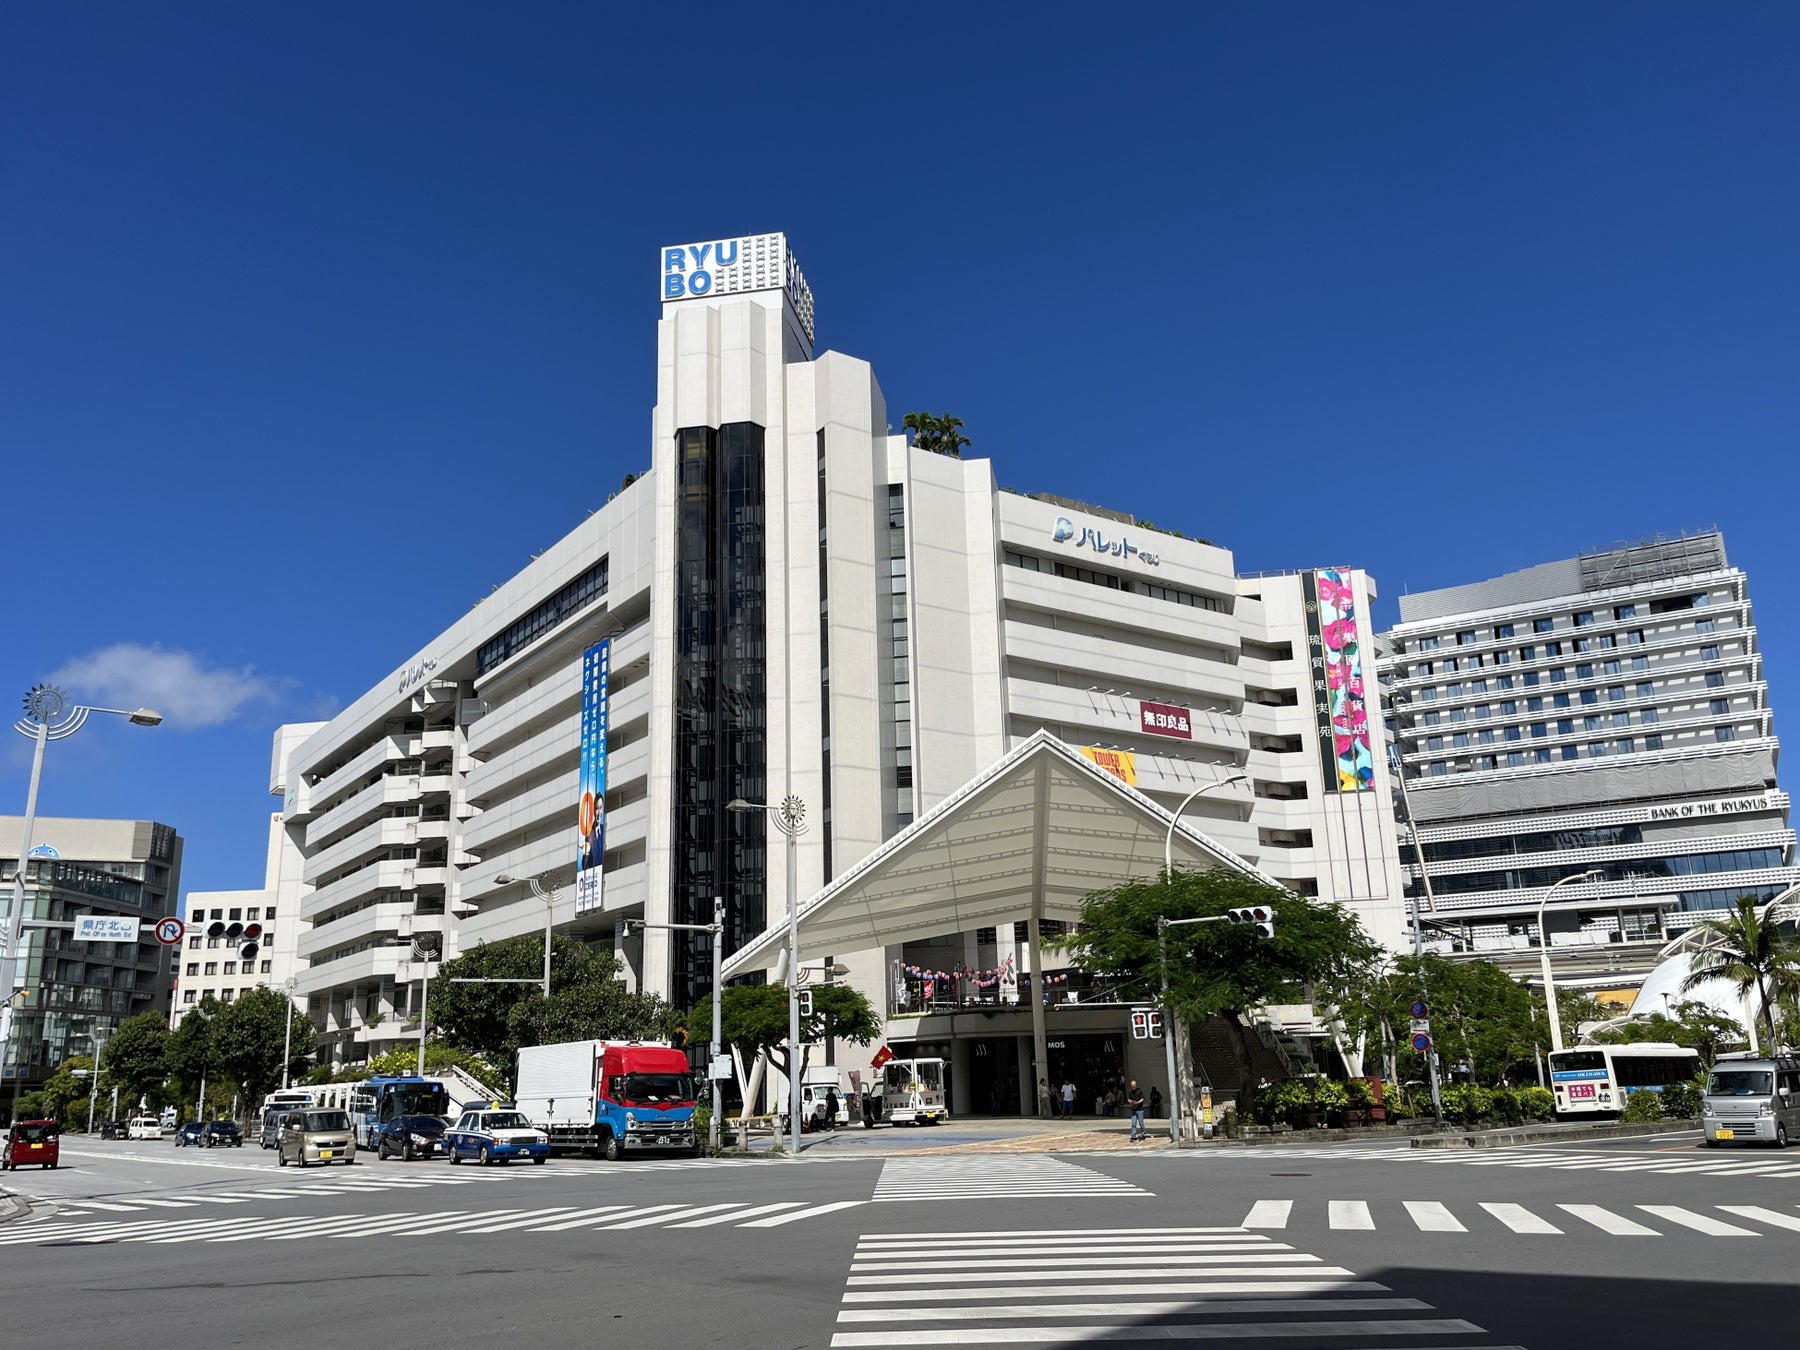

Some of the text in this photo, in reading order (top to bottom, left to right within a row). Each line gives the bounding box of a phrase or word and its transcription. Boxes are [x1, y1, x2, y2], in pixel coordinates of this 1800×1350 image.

[665, 240, 738, 273] RYU
[665, 270, 712, 298] BO
[1143, 710, 1189, 732] 無印良品
[1093, 751, 1121, 767] TOWER
[1651, 798, 1768, 819] BANK OF THE RYUKYUS
[82, 919, 132, 931] 県庁北口
[1047, 1041, 1066, 1049] MOS
